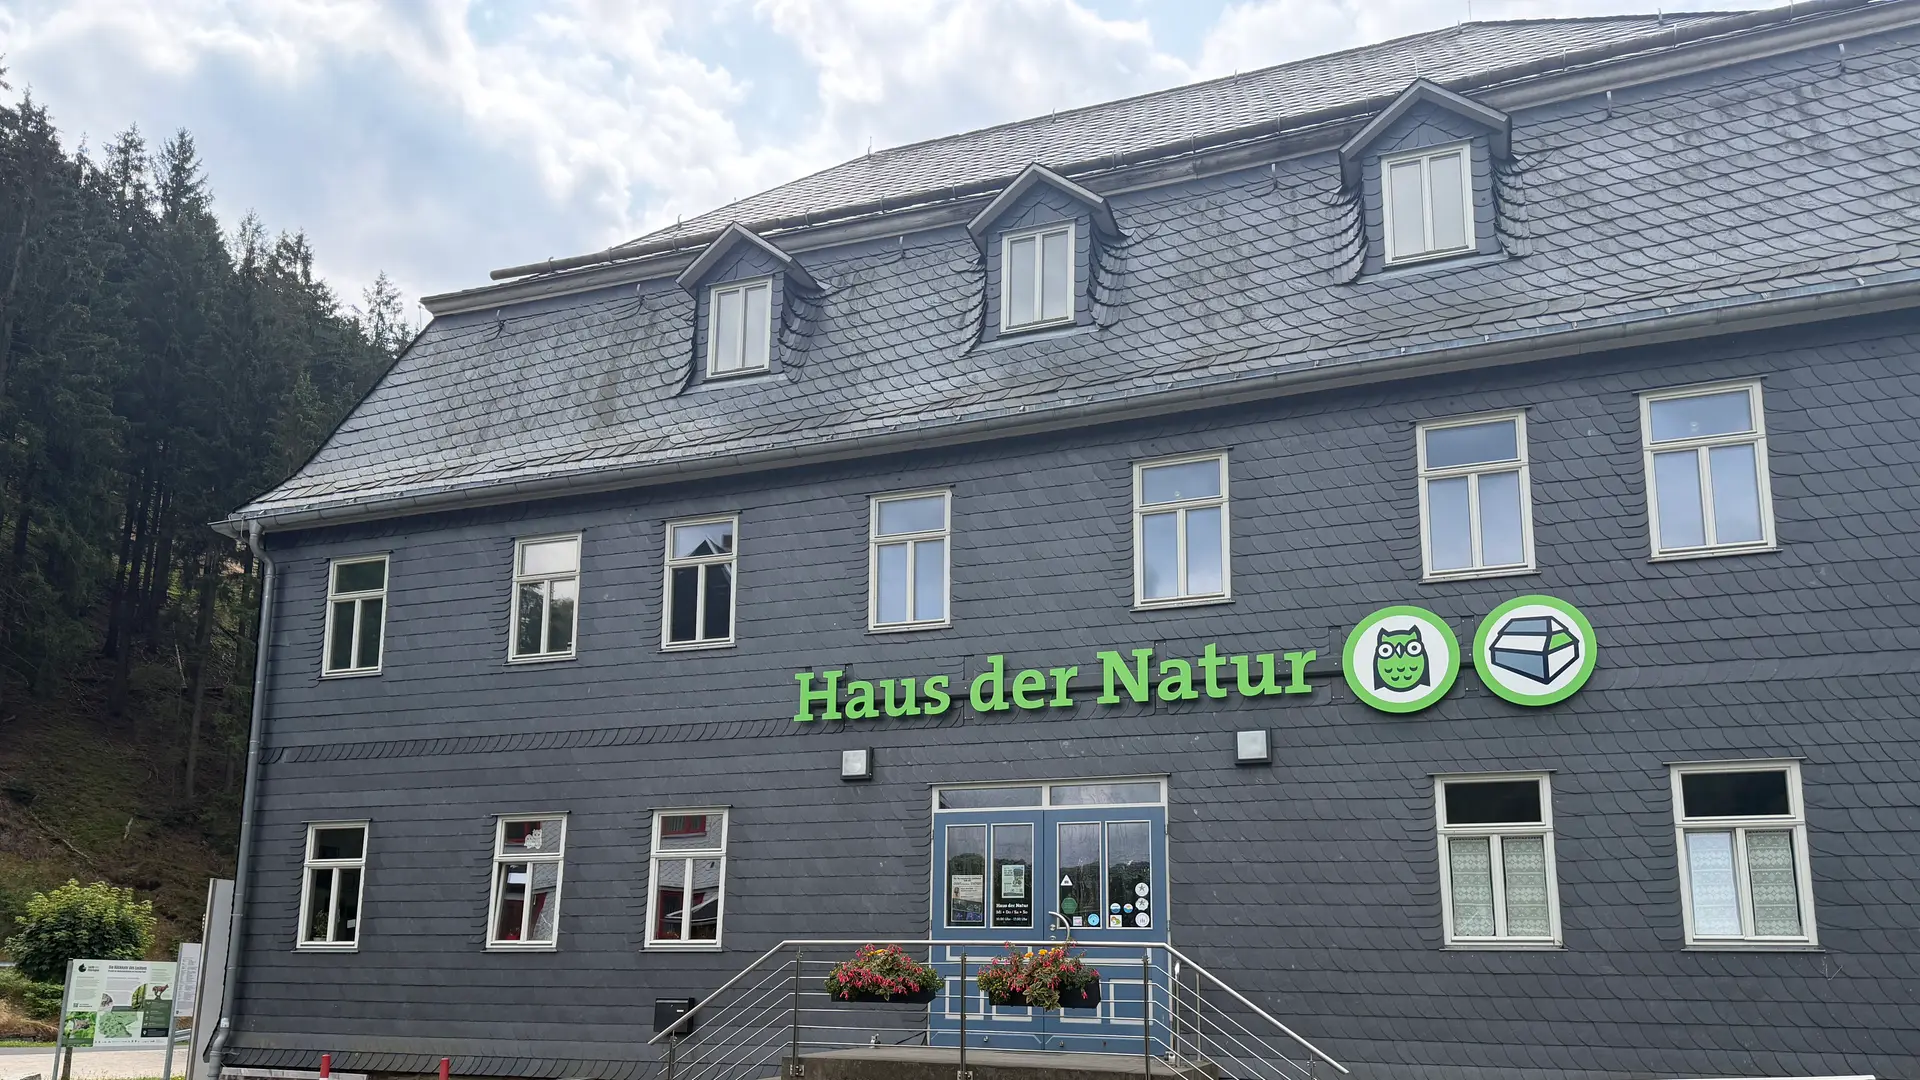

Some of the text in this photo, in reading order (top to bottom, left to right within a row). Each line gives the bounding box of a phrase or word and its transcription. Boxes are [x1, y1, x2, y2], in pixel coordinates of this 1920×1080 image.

[794, 643, 1317, 722] Haus der Natur
